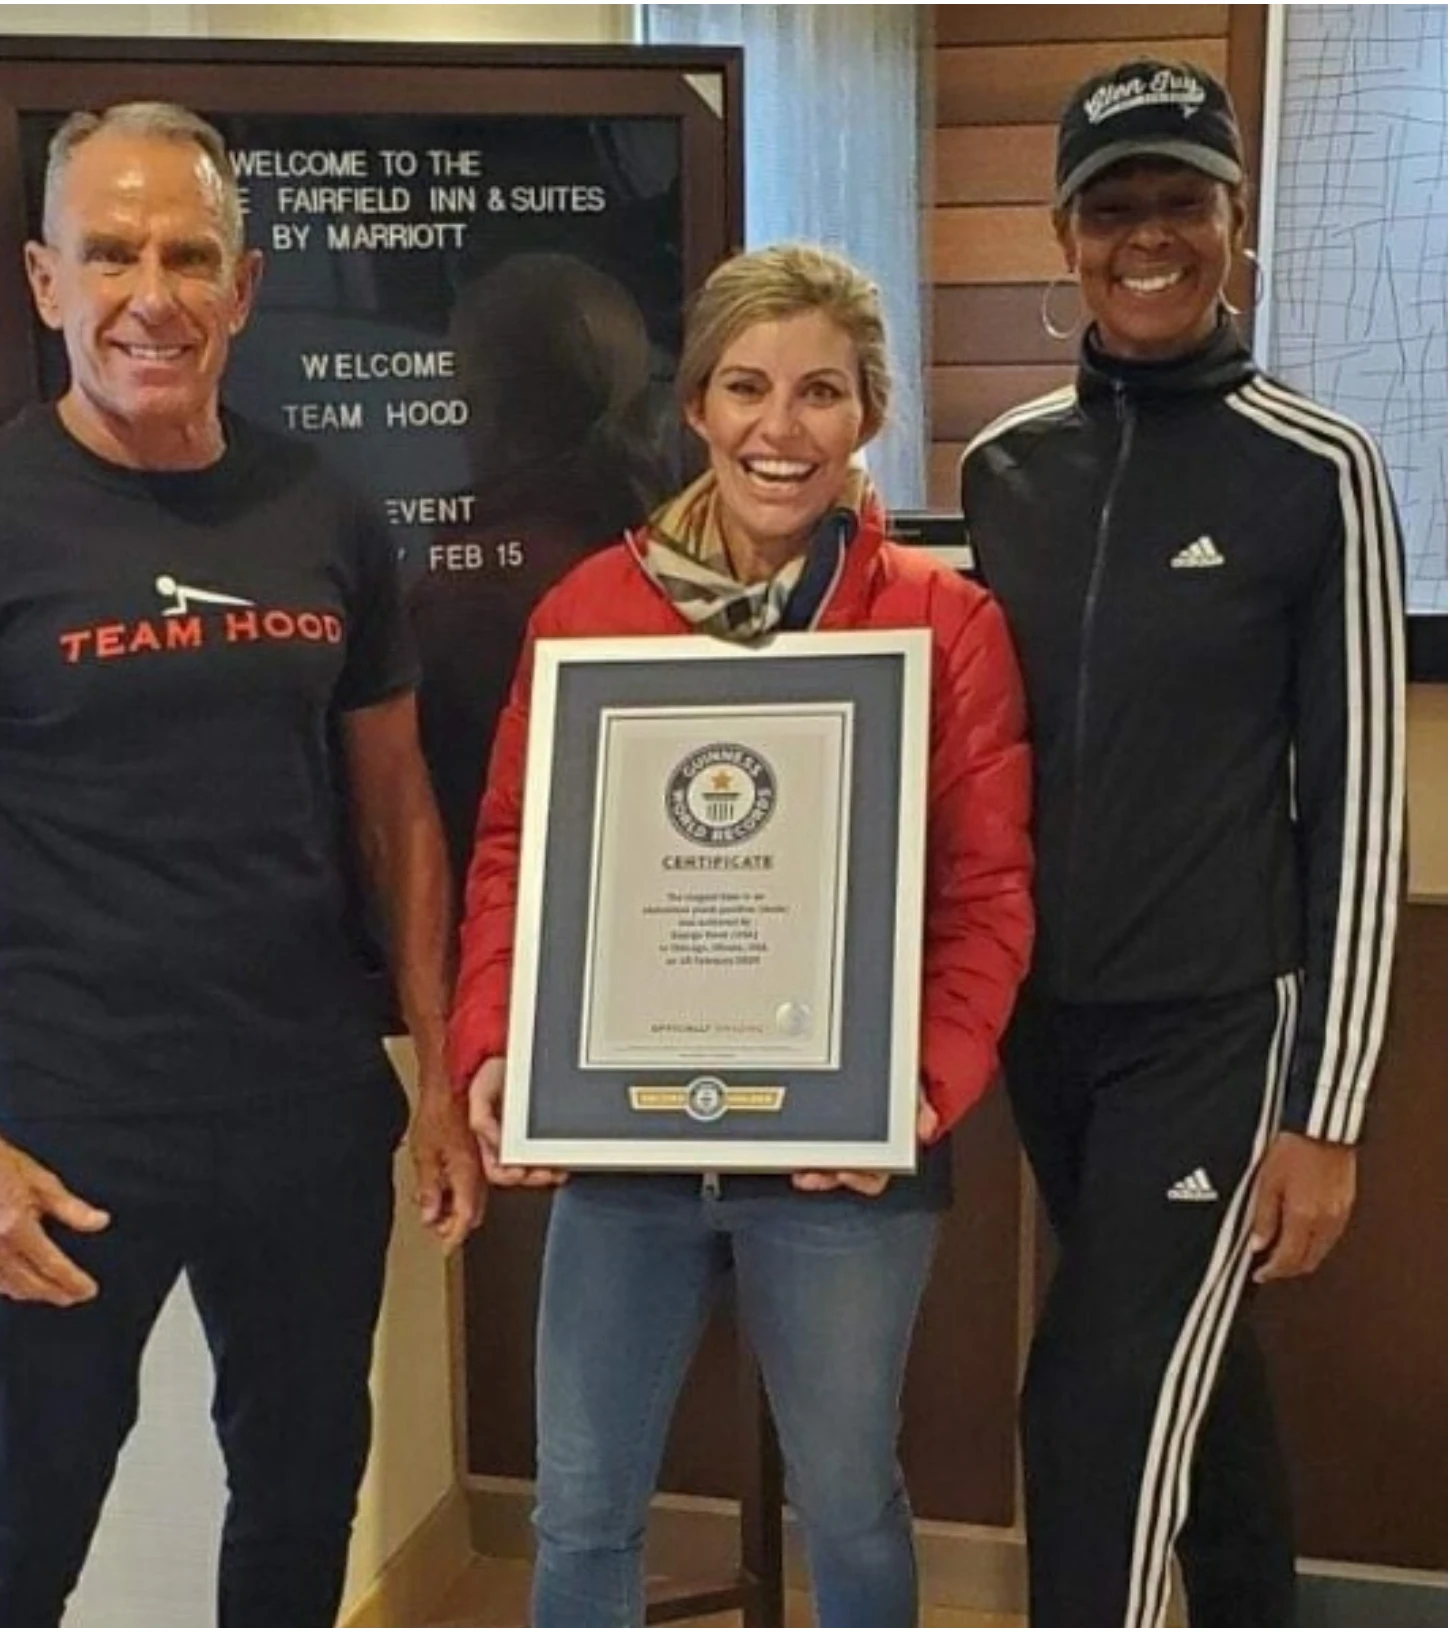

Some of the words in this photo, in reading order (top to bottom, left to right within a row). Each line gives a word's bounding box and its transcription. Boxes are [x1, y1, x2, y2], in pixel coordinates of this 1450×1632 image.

[231, 150, 367, 176] WELCOME
[380, 151, 417, 176] TO
[427, 151, 482, 176] THE
[278, 188, 410, 213] FAIRFIELD
[430, 188, 475, 212] INN
[488, 188, 503, 212] &
[510, 187, 606, 212] SUITES
[272, 225, 310, 249] BY
[328, 223, 466, 248] MARRIOTT
[302, 352, 456, 380] WELCOME
[282, 404, 363, 430] TEAM
[386, 401, 468, 427] HOOD
[429, 544, 483, 570] FEB
[496, 542, 523, 567] 15
[59, 617, 202, 664] TEAM
[226, 609, 343, 644] HOOD
[661, 855, 774, 871] CERTIFICATE
